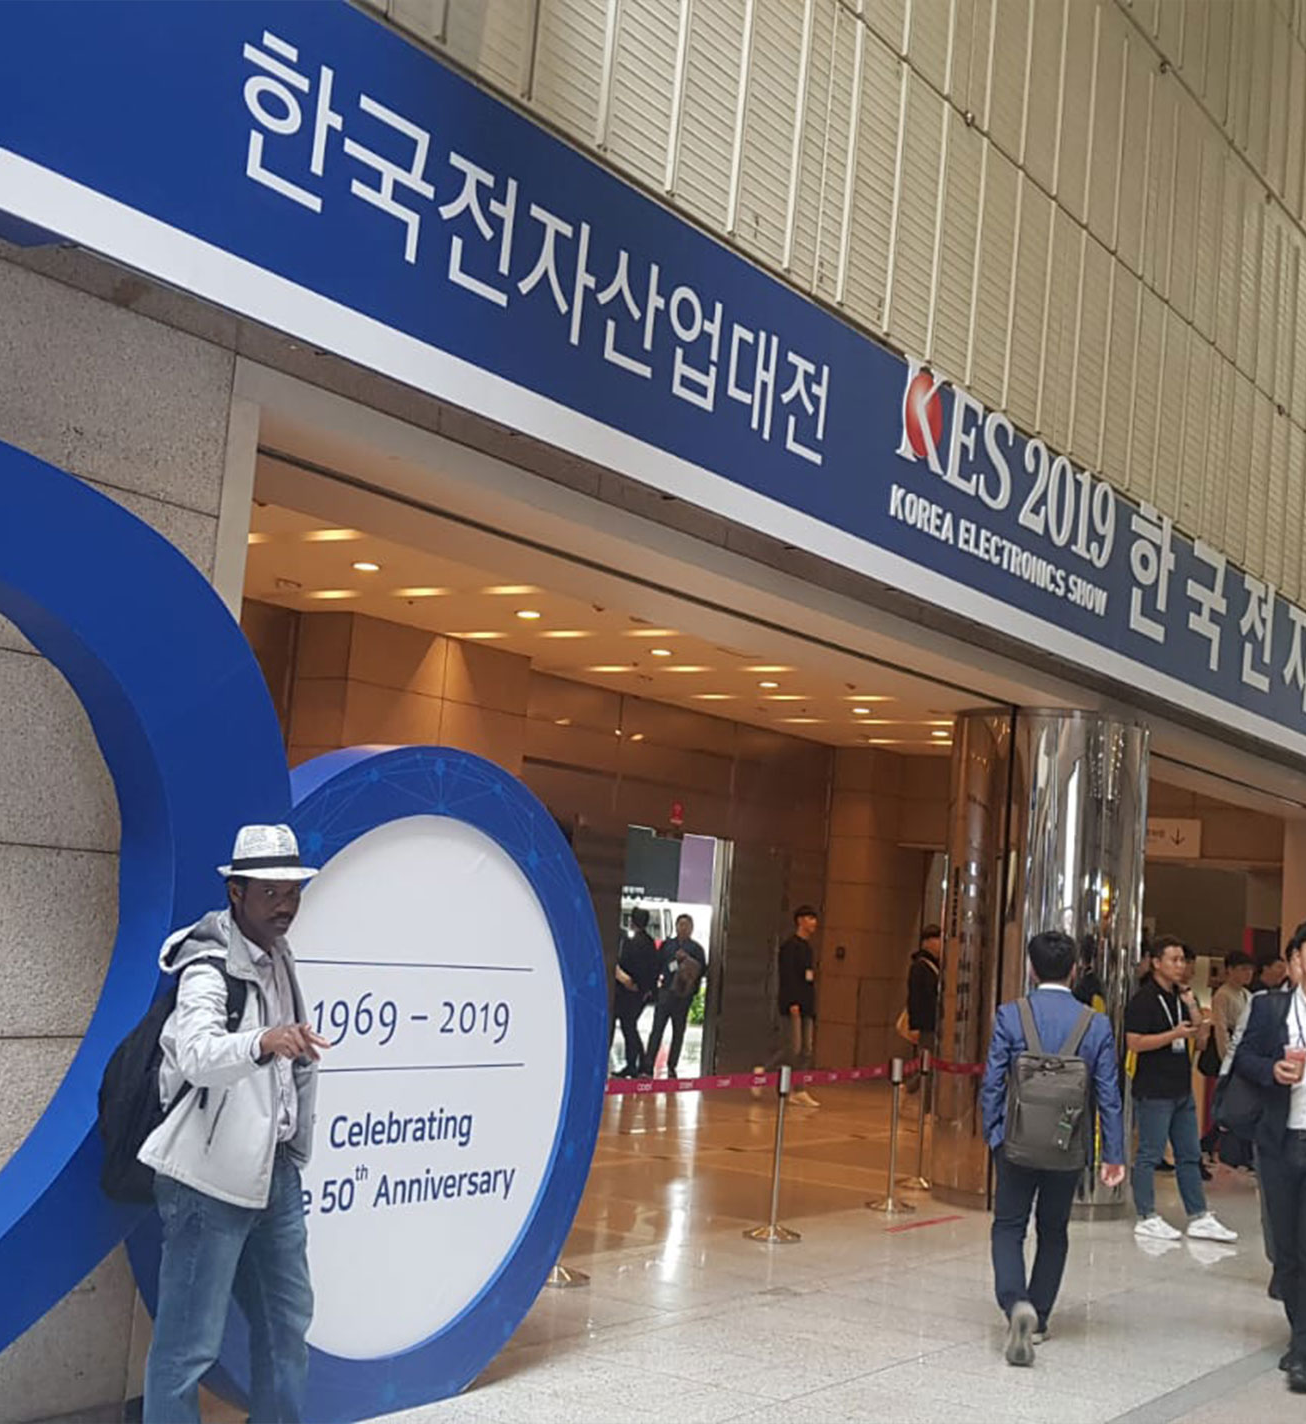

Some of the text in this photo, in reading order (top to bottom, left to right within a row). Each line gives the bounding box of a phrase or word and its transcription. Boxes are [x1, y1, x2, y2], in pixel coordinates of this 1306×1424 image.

[242, 30, 831, 466] 한국전자산업대전
[896, 355, 1116, 569] KES 2019
[889, 483, 1108, 616] KOREA ELECTRONICS SHOW
[312, 993, 397, 1046] 1969
[439, 1001, 511, 1045] 2019
[329, 1107, 473, 1150] Celebrating
[373, 1166, 516, 1208] Anniversary
